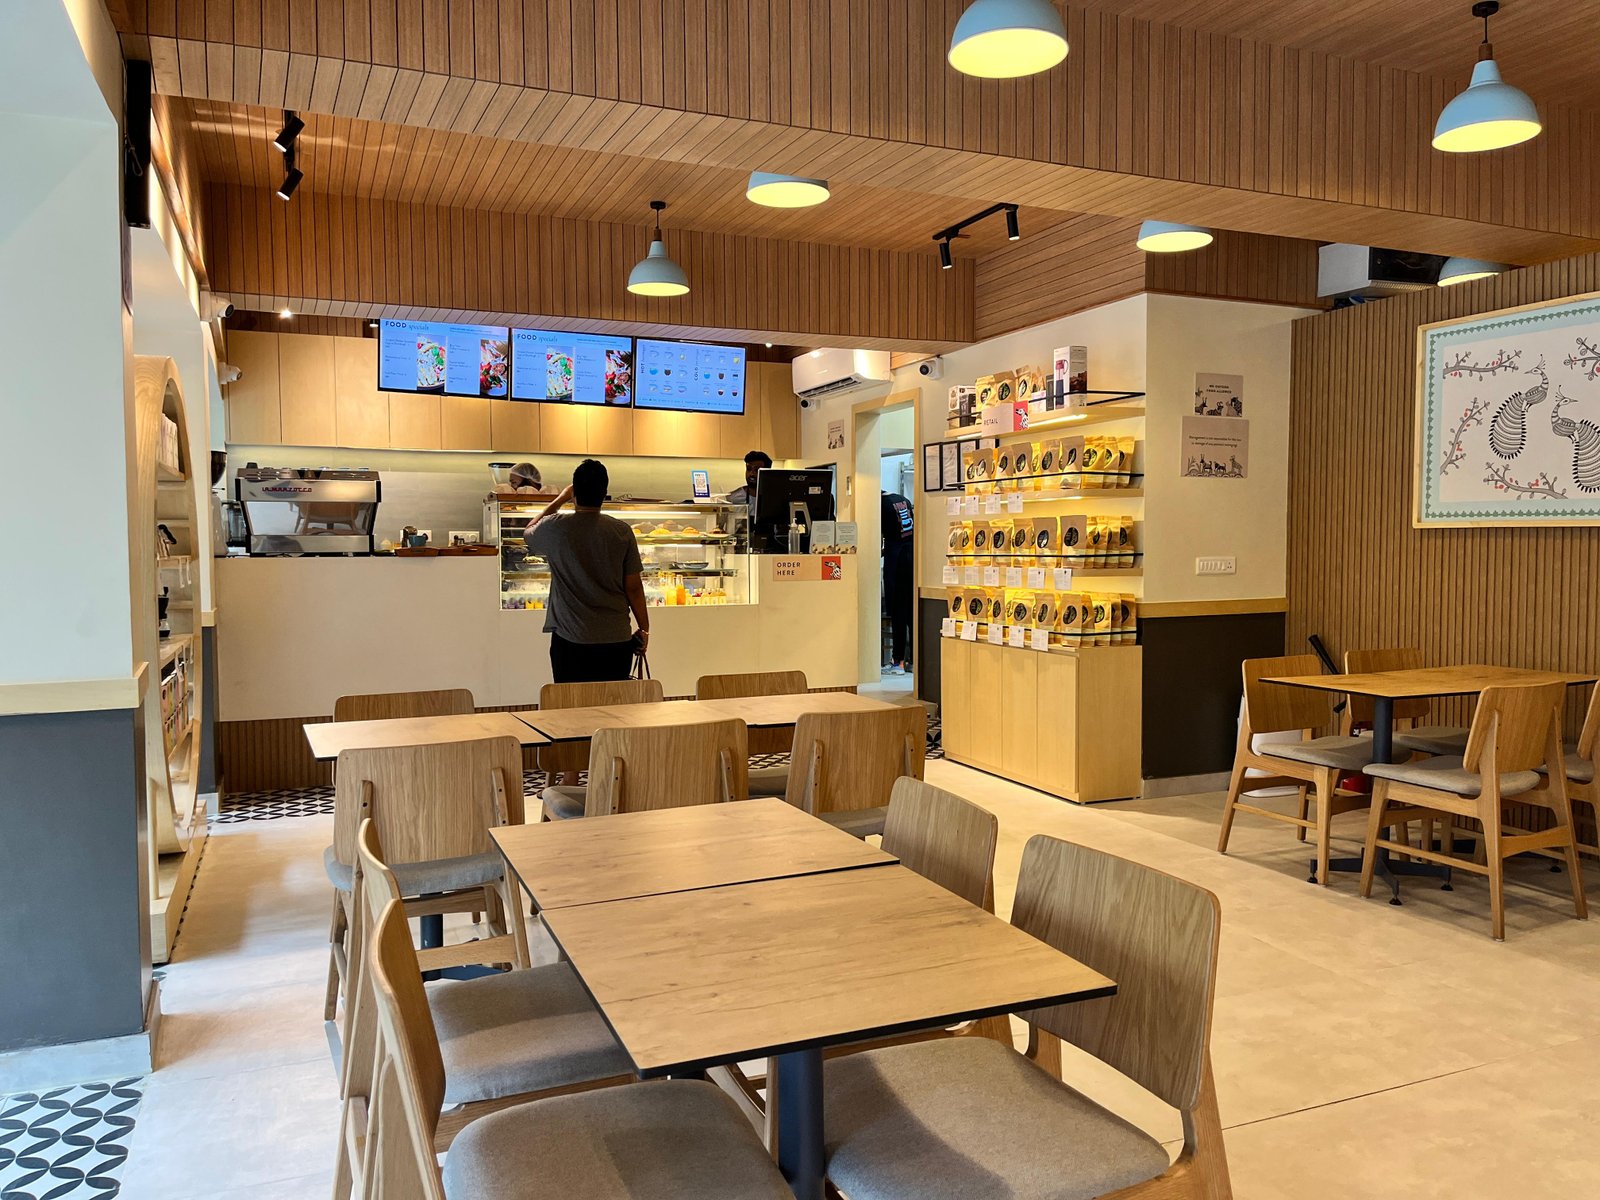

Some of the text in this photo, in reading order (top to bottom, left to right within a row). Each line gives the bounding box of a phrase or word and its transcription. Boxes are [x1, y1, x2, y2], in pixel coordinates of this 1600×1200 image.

[385, 320, 407, 328] FOOD
[517, 333, 537, 341] FOOD
[983, 418, 999, 426] RETAIL
